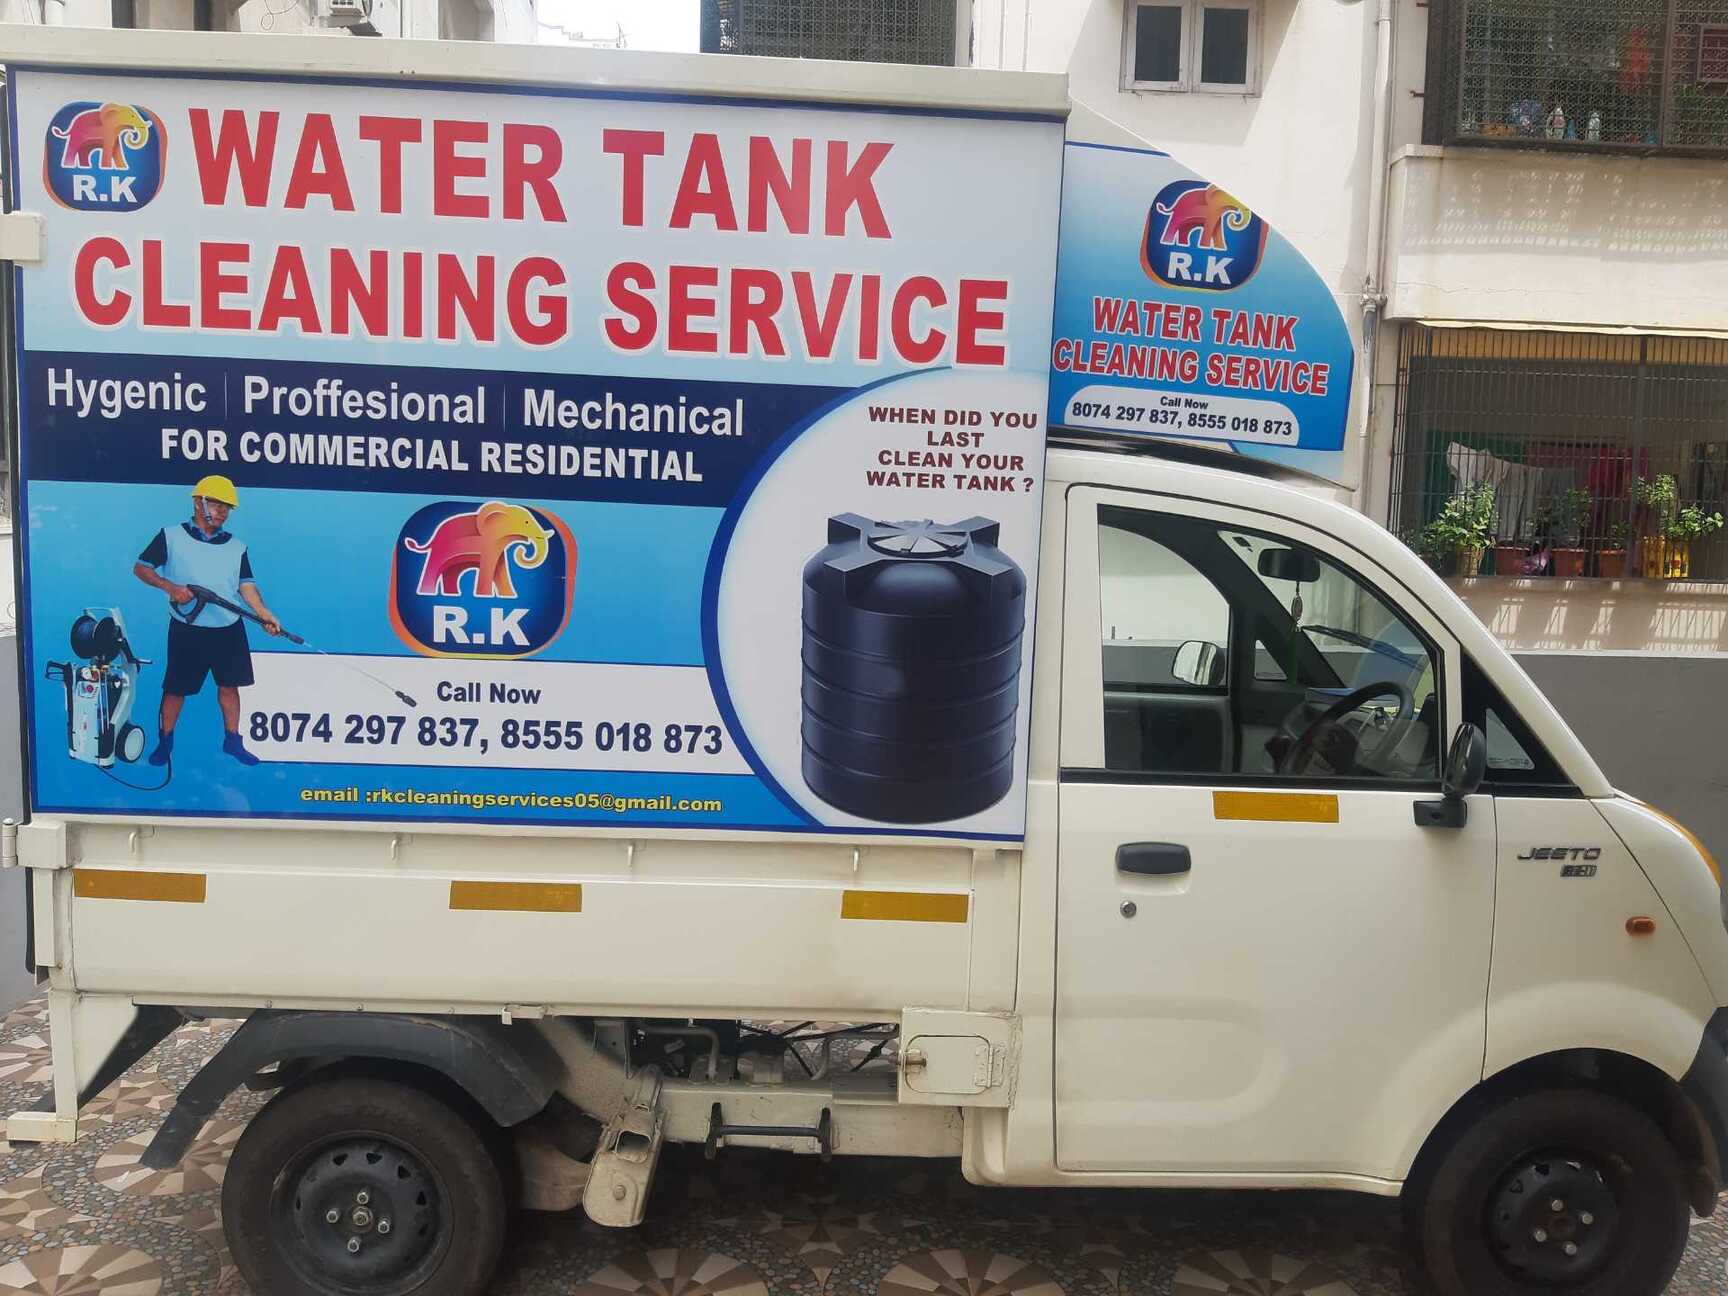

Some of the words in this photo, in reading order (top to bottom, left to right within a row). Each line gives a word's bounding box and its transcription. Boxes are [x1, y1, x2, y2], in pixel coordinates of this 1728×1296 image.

[72, 174, 138, 205] R.K
[188, 108, 568, 223] WATER
[602, 128, 895, 239] TANK
[1167, 252, 1233, 285] R.K
[73, 236, 568, 346] CLEANING
[604, 261, 1008, 366] SERVICE
[1093, 297, 1201, 342] WATER
[1211, 309, 1297, 351] TANK
[1053, 338, 1198, 384] CLEANING
[1206, 354, 1329, 395] SERVICE
[47, 368, 207, 420] Hygenic
[244, 376, 486, 425] Proffesional
[523, 388, 744, 437] Mechanical
[868, 406, 936, 424] WHEN
[944, 409, 982, 426] DID
[990, 411, 1037, 428] YOU
[1072, 402, 1111, 420] 8074
[1115, 405, 1145, 422] 297
[1149, 409, 1182, 428] 837,
[1187, 412, 1226, 430] 8555
[1231, 416, 1258, 433] 018
[1263, 418, 1292, 436] 873
[1160, 395, 1181, 408] Call
[1184, 399, 1208, 410] Now
[162, 428, 228, 463] FOR
[239, 432, 469, 472] COMMERCIAL
[480, 441, 703, 482] RESIDENTIAL
[927, 431, 984, 448] LAST
[878, 450, 953, 468] CLEAN
[961, 453, 1024, 471] YOUR
[866, 471, 945, 489] WATER
[953, 475, 1015, 492] TANK
[1023, 477, 1034, 492] ?
[432, 605, 531, 647] R.K
[436, 681, 480, 704] Call
[489, 683, 541, 705] Now
[249, 711, 333, 744] 8074
[344, 714, 406, 745] 297
[417, 716, 489, 755] 837,
[500, 719, 584, 751] 8555
[595, 721, 652, 753] 018
[663, 723, 723, 755] 873
[300, 787, 359, 803] email
[1517, 848, 1601, 860] JEETO
